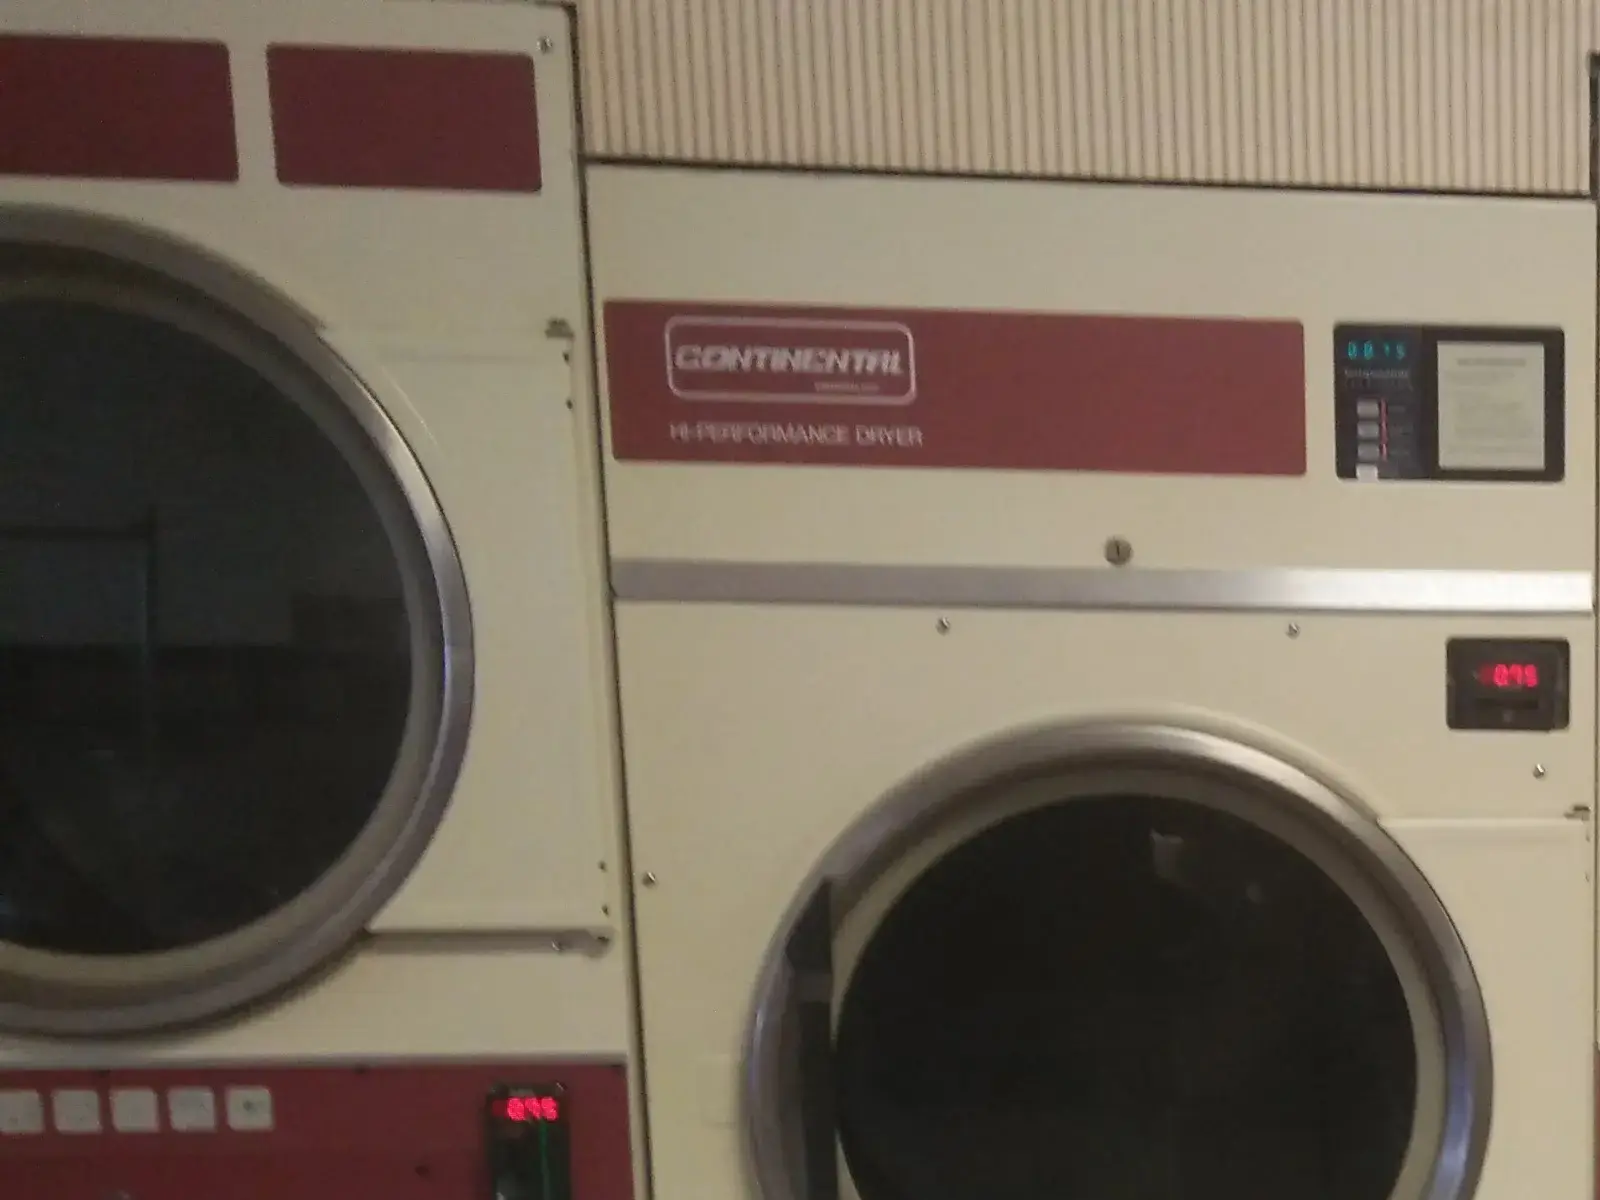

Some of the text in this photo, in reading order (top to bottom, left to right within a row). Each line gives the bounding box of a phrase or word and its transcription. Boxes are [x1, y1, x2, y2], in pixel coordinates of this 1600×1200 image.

[674, 344, 904, 375] CONTINENTAL
[669, 421, 923, 448] HI-PERFORMANCE DRYER
